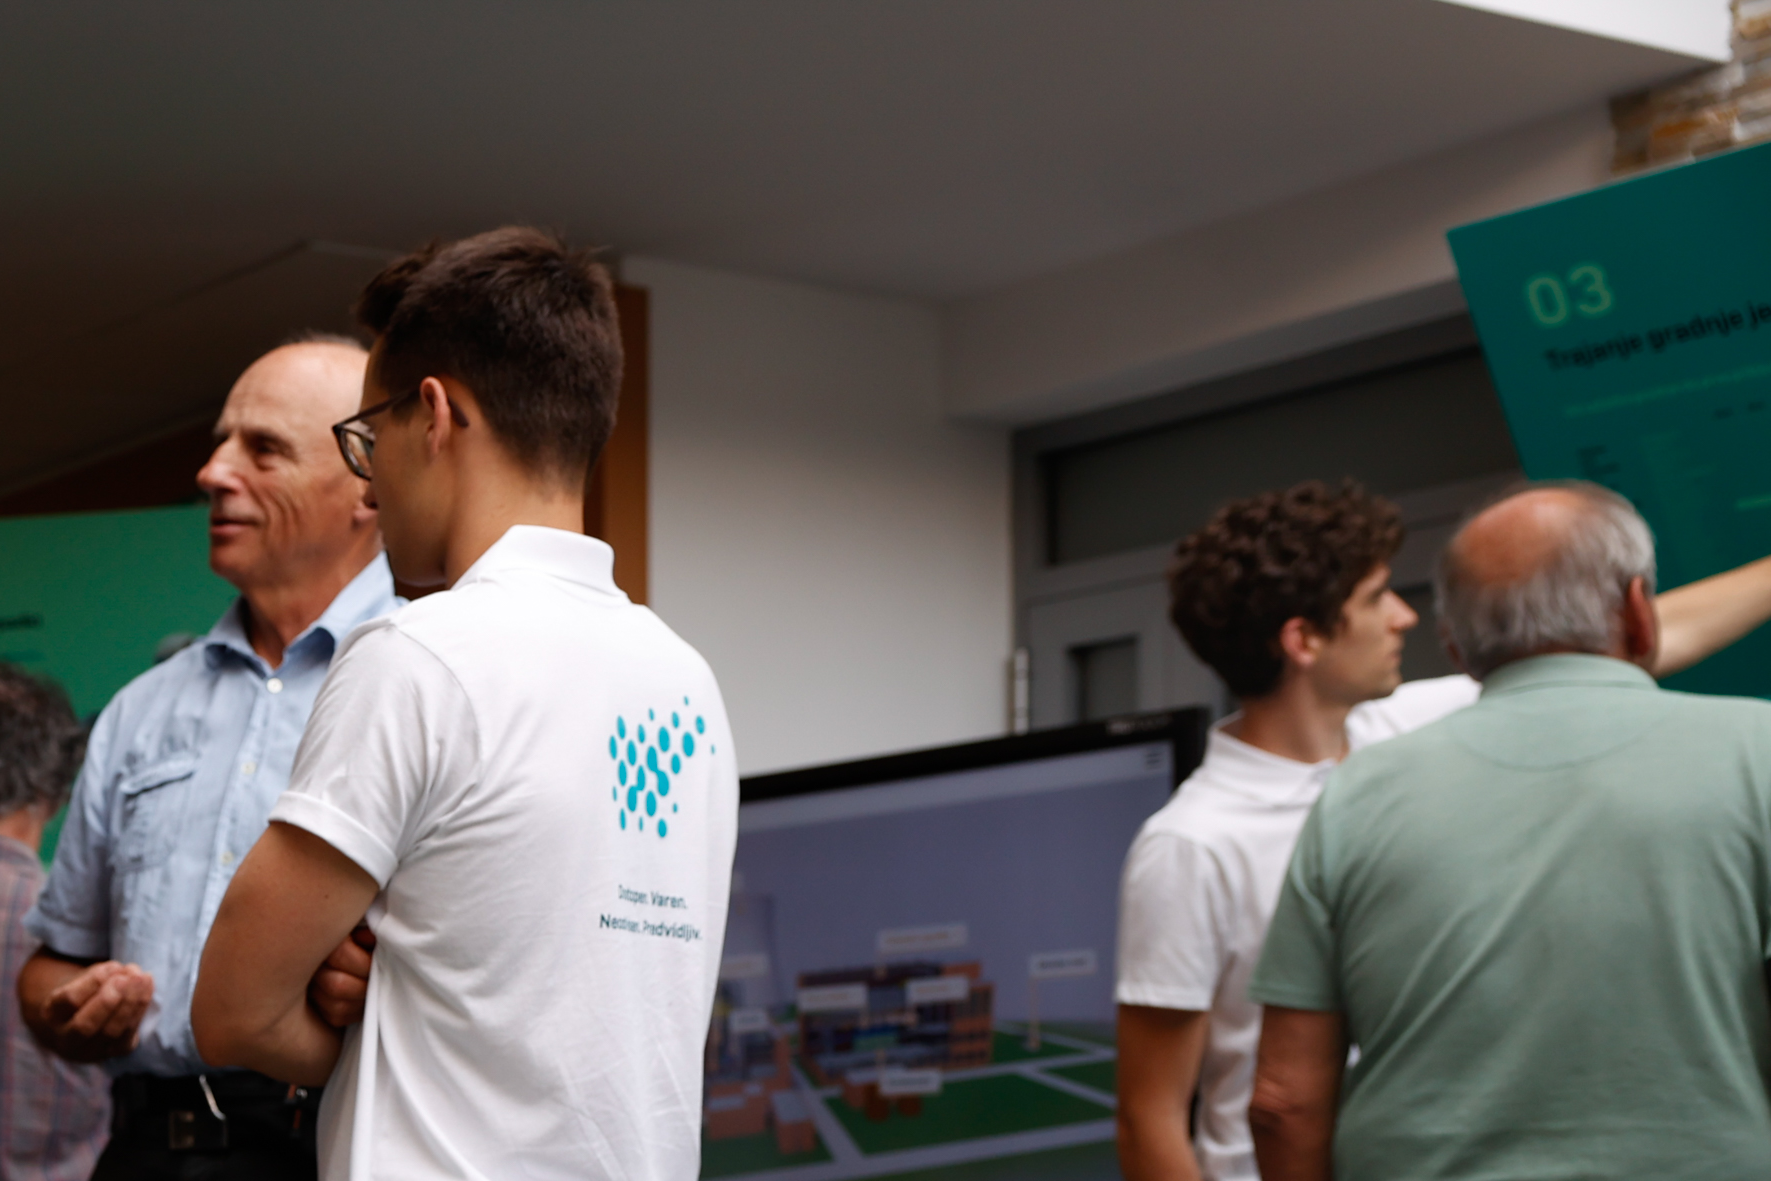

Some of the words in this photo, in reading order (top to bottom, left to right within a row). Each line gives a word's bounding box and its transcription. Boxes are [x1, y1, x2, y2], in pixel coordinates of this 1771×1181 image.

[1527, 265, 1612, 325] 03
[1646, 308, 1745, 354] gradnje
[650, 890, 688, 909] Varen.
